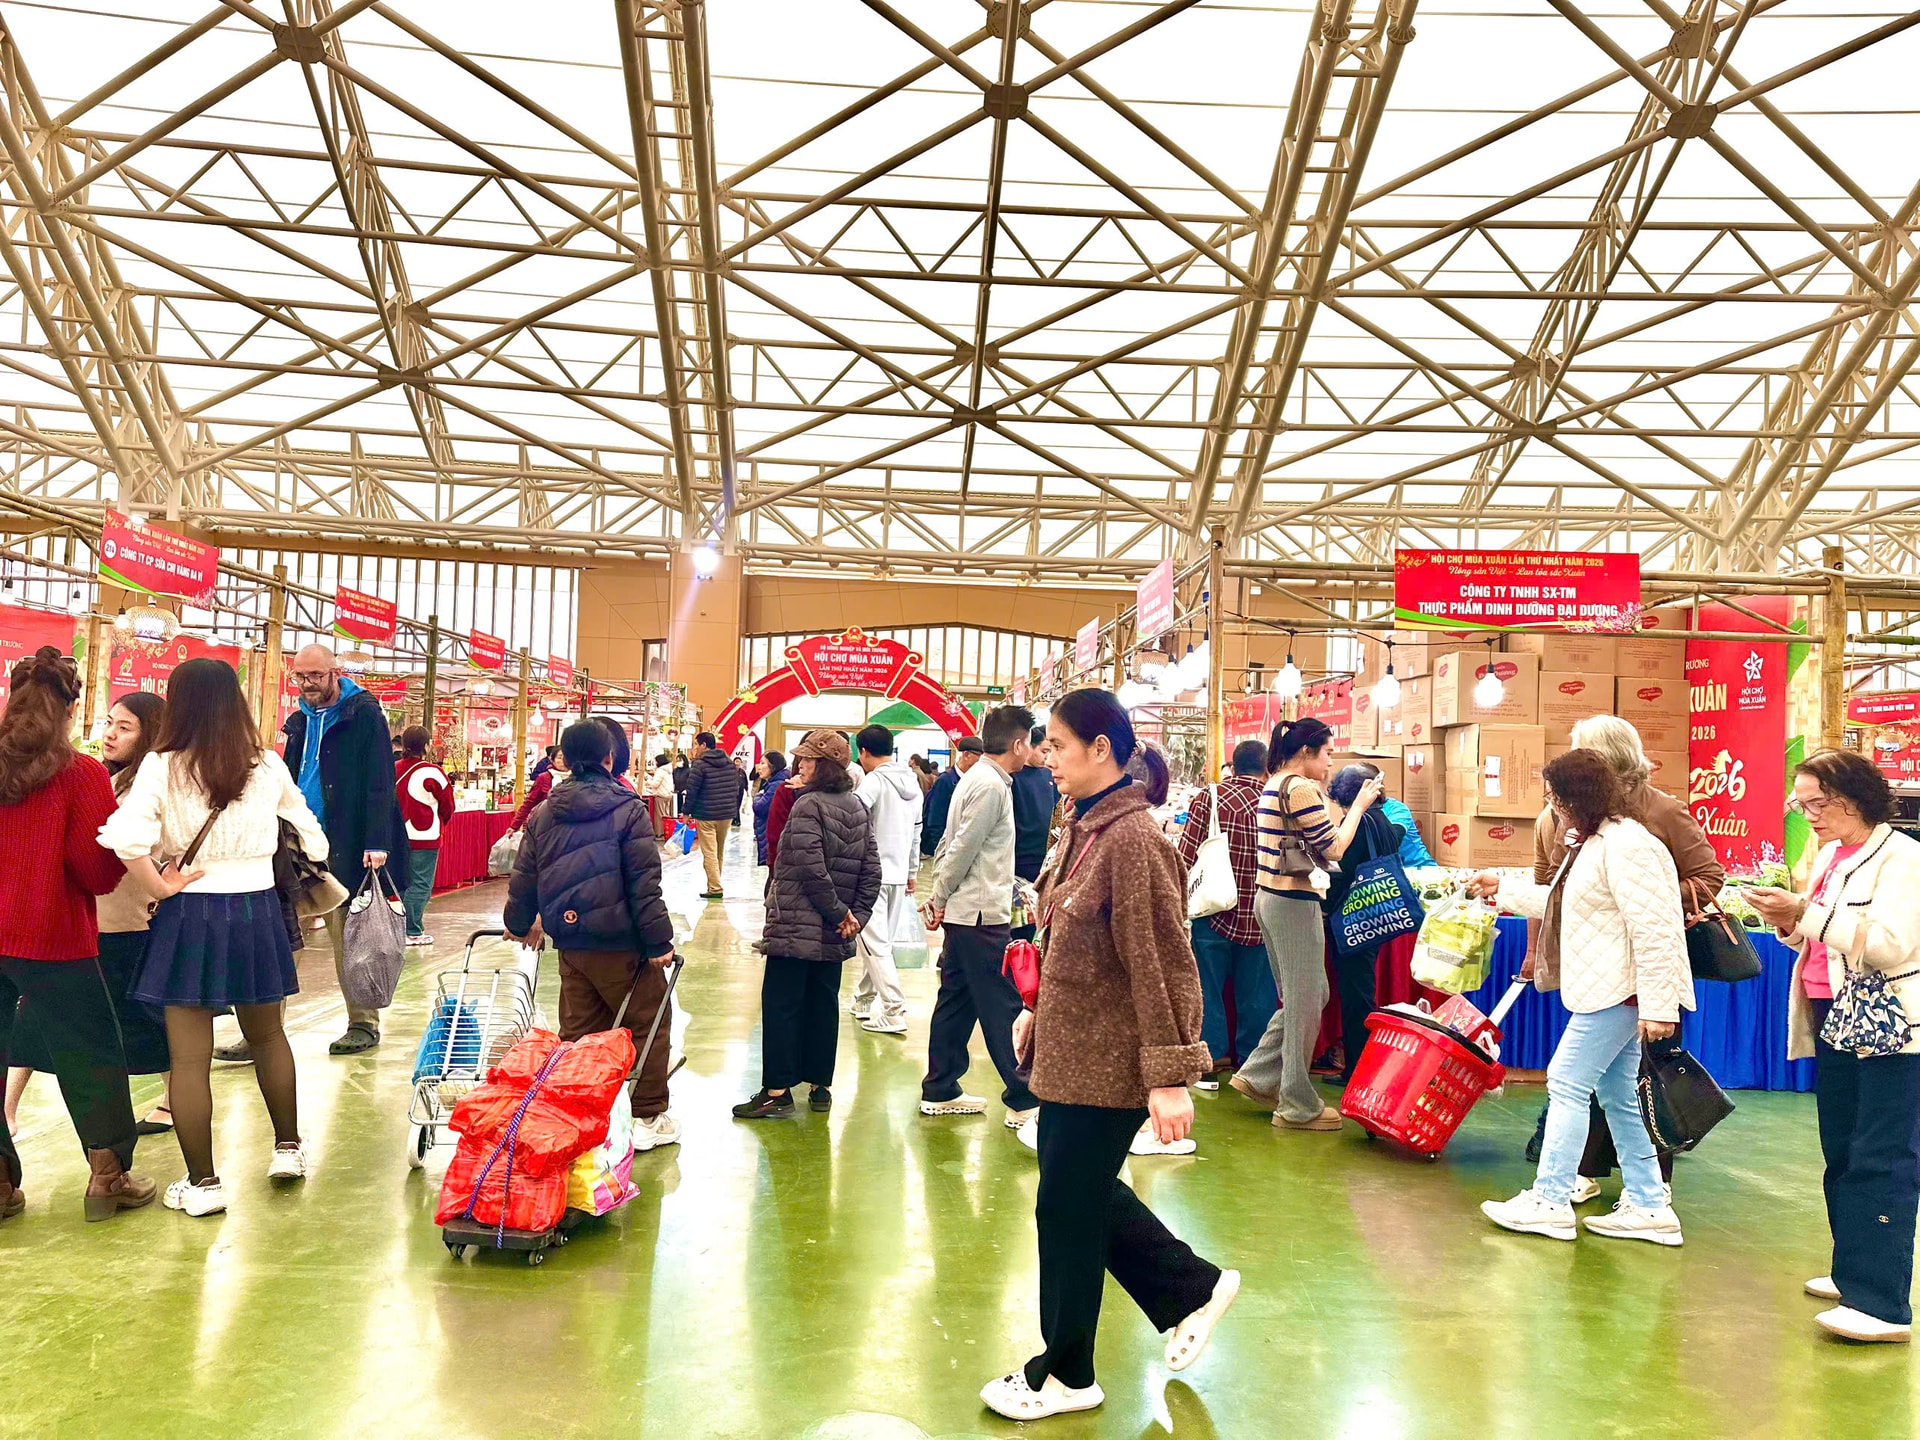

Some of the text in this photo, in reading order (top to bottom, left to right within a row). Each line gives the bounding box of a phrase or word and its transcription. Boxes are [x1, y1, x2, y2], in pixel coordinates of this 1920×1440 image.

[120, 546, 137, 562] CÔNG
[137, 552, 145, 563] TY
[145, 555, 154, 566] CP
[155, 557, 166, 570] SỮA
[166, 562, 176, 576] CHỊ
[1431, 553, 1445, 565] HỘI
[1447, 554, 1463, 565] CHỢ
[1465, 554, 1483, 564] MÙA
[1485, 554, 1506, 564] XUÂN
[1509, 554, 1524, 565] LẦN
[1526, 555, 1542, 565] THỨ
[1543, 554, 1564, 566] NHẤT
[1565, 556, 1583, 566] NĂM
[1449, 566, 1472, 577] Nông
[1488, 566, 1506, 576] Việt
[1516, 567, 1533, 576] Lan
[1535, 568, 1548, 576] tỏa
[1550, 568, 1562, 576] sắc
[1563, 568, 1585, 576] Xuân
[1460, 583, 1576, 599] CÔNG TY TNHH SX-TM
[1418, 598, 1618, 618] THỰC PHẨM DINH DƯỠNG ĐẠI DƯƠNG
[814, 652, 893, 665] HỘI CHỢ MÙA XUÂN
[1686, 658, 1709, 670] RƯỜNG
[158, 678, 168, 694] CH
[1742, 686, 1764, 696] HỘI CHỢ
[1751, 695, 1766, 703] XUÂN
[1691, 725, 1716, 740] 2026
[1900, 757, 1914, 774] HỘI
[1690, 760, 1746, 805] 2026
[406, 766, 449, 840] S
[1696, 806, 1749, 837] Xuân
[1342, 887, 1401, 916] GROWING
[1342, 898, 1405, 926] GROWING
[1344, 908, 1410, 936] GROWING
[1347, 918, 1414, 946] GROWING
